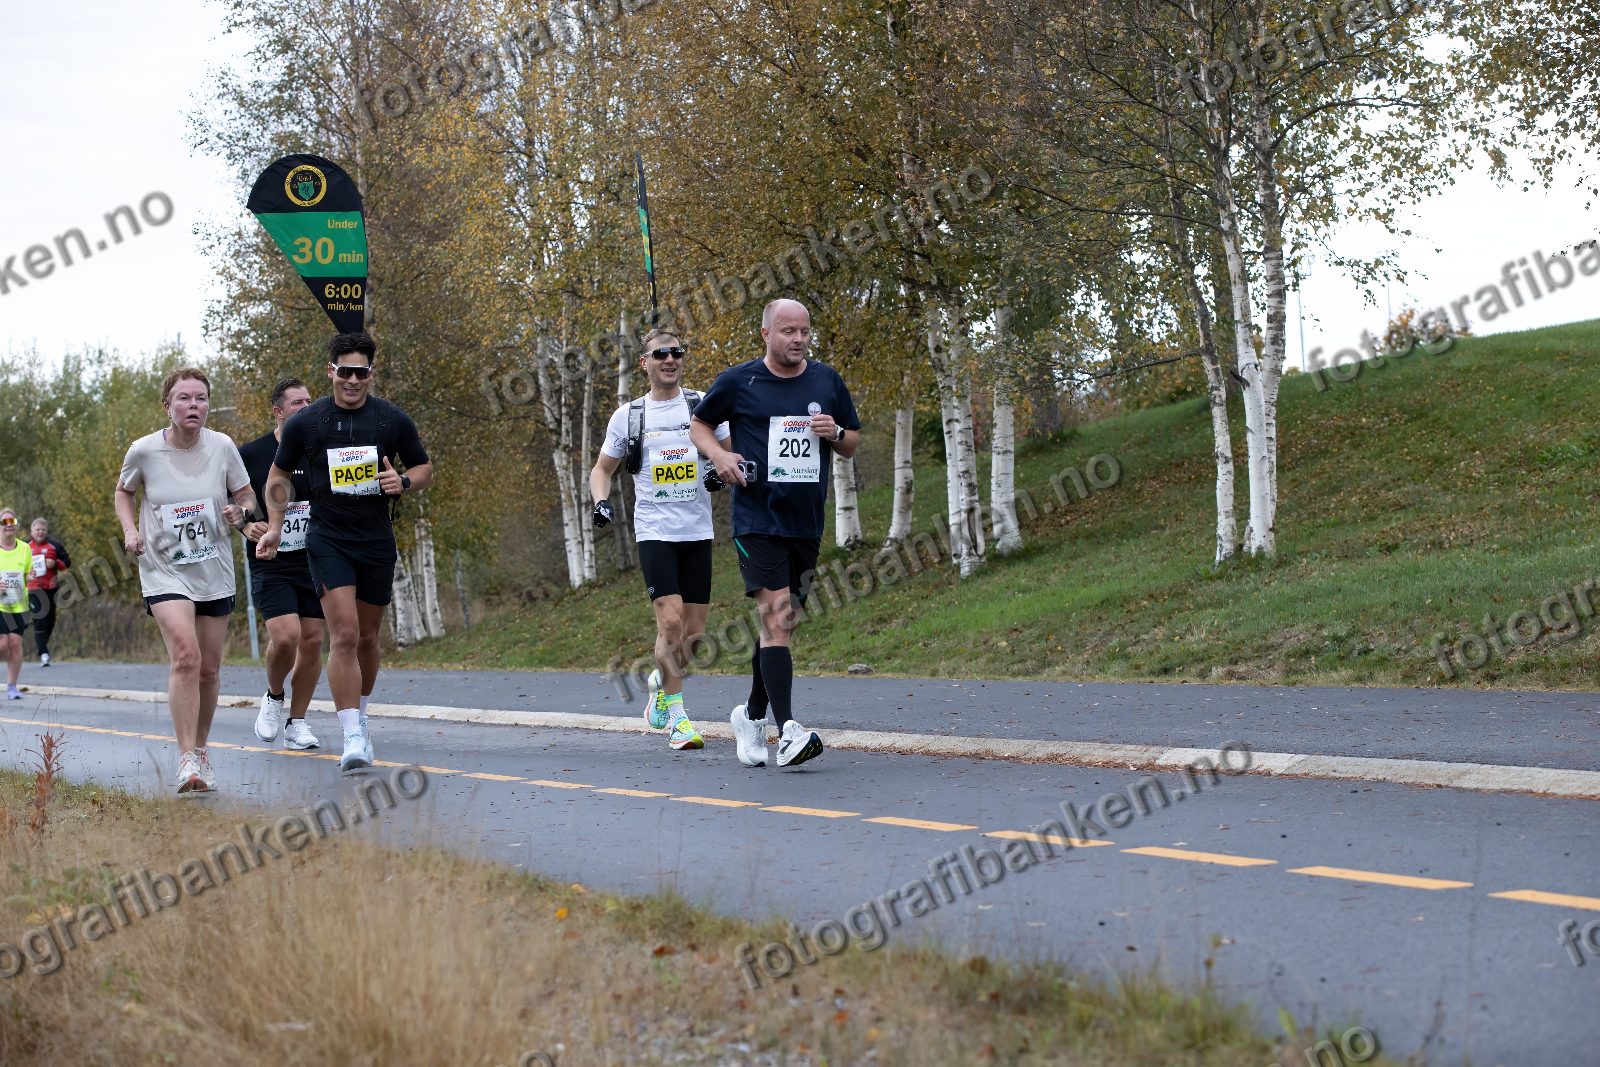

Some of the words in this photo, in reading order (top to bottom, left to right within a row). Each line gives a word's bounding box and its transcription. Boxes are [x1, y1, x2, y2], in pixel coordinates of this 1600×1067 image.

[327, 219, 359, 229] Under
[292, 236, 335, 265] 30
[338, 250, 364, 263] min
[324, 283, 362, 299] 6:00
[327, 302, 364, 313] min/km
[779, 438, 811, 458] 202
[334, 464, 374, 484] PACE
[655, 464, 695, 482] PACE
[173, 520, 208, 542] 764
[283, 518, 309, 534] 347
